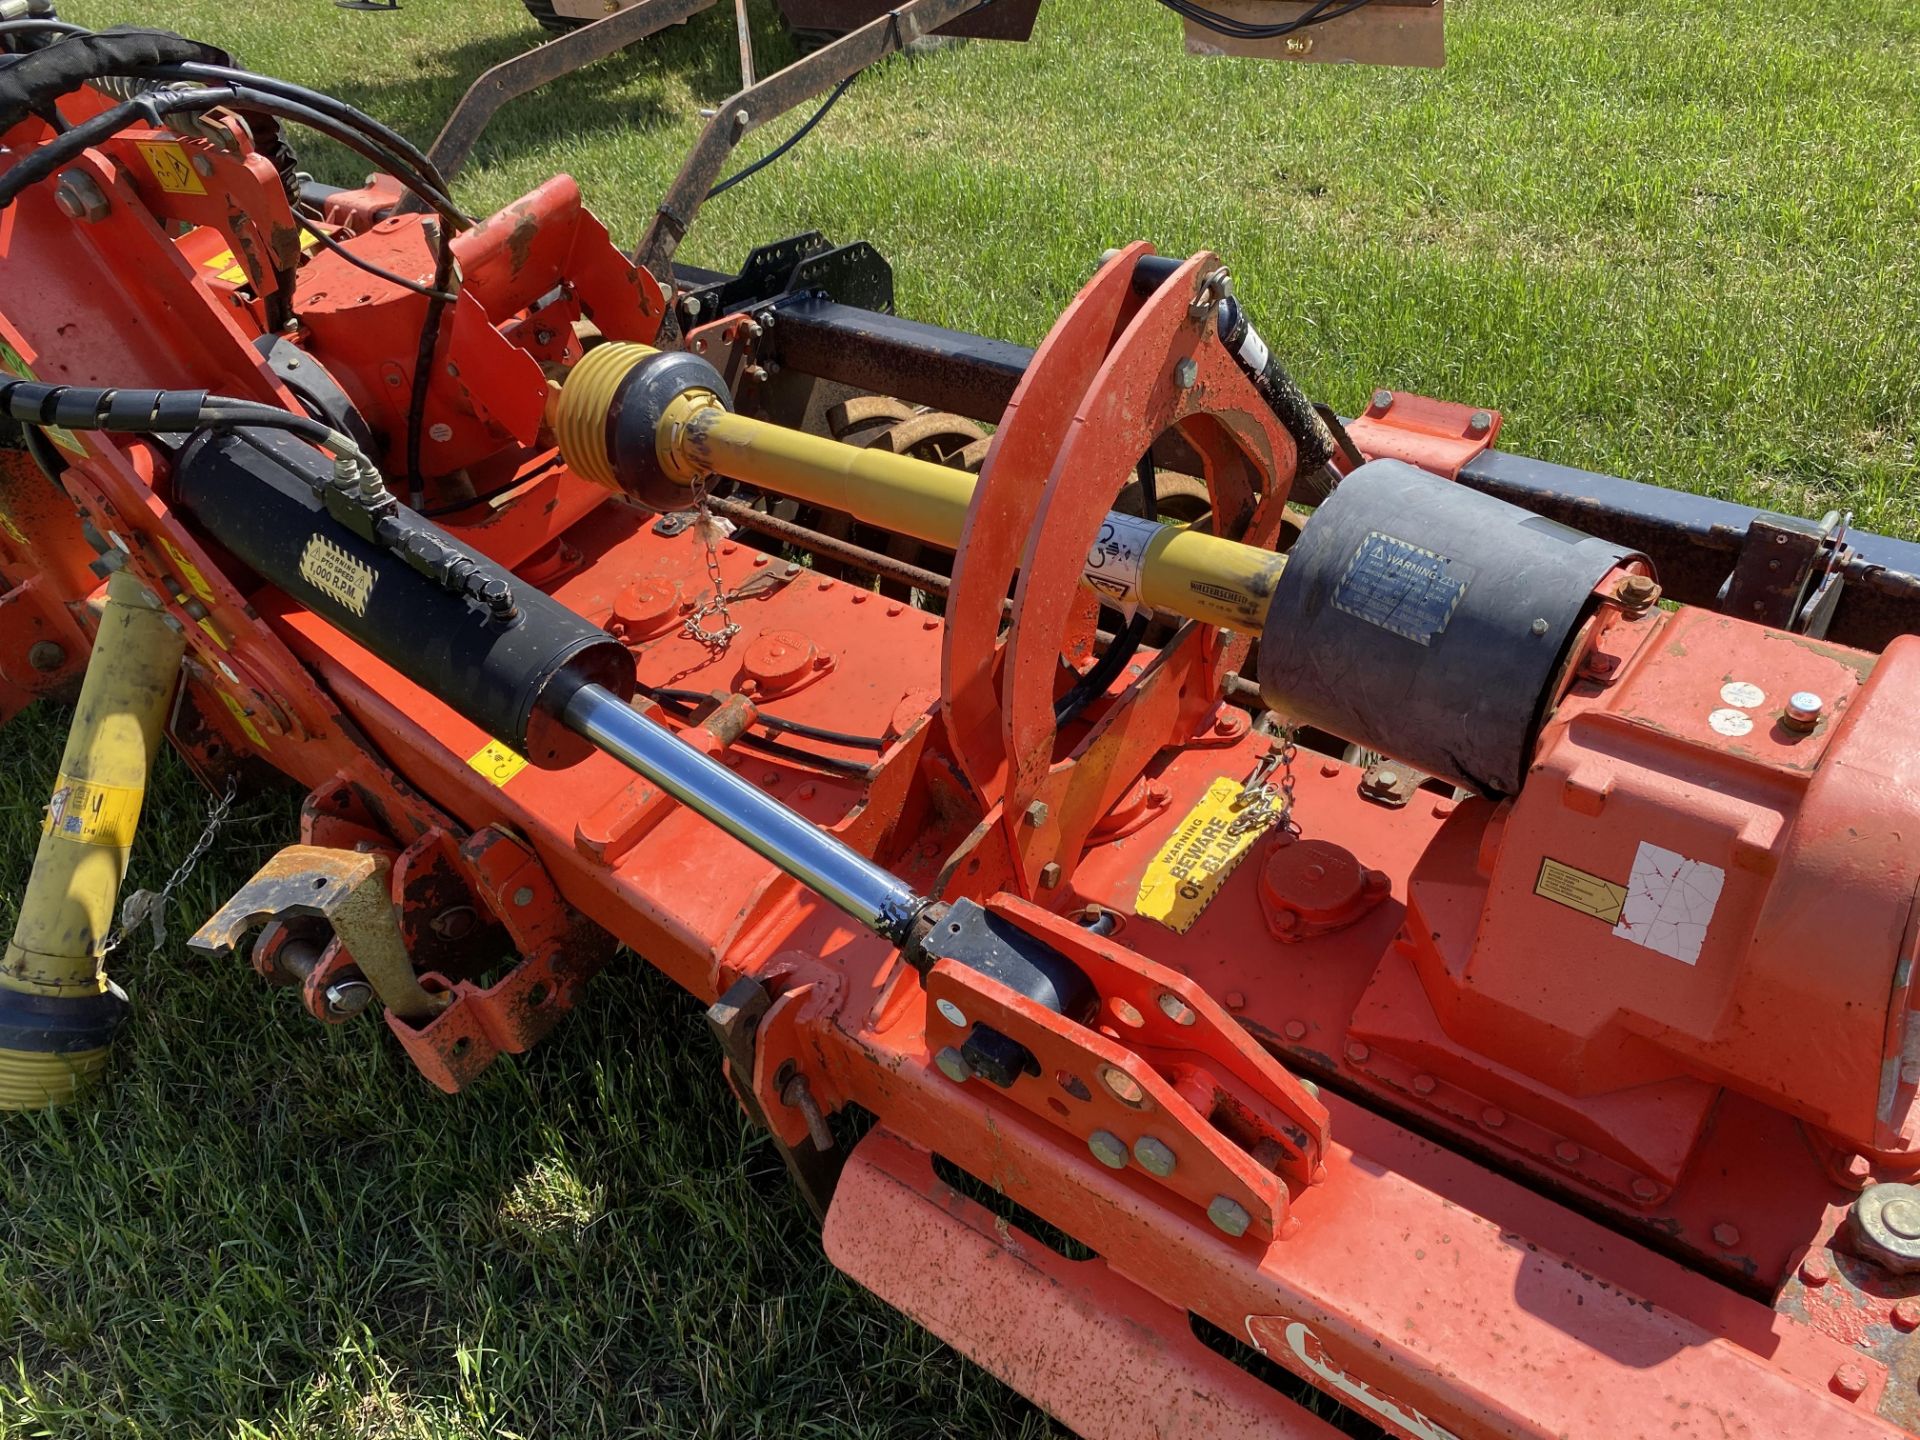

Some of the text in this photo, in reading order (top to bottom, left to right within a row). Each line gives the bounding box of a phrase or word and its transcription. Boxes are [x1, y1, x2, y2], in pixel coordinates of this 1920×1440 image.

[321, 557, 354, 583] PTO SPEED
[325, 551, 356, 575] WARNING
[1386, 554, 1438, 580] WARNING
[309, 561, 356, 600] 1,000 R.P.M.
[1162, 818, 1203, 864] WARNING
[1170, 816, 1228, 881] BEWARE
[1180, 876, 1205, 900] OF
